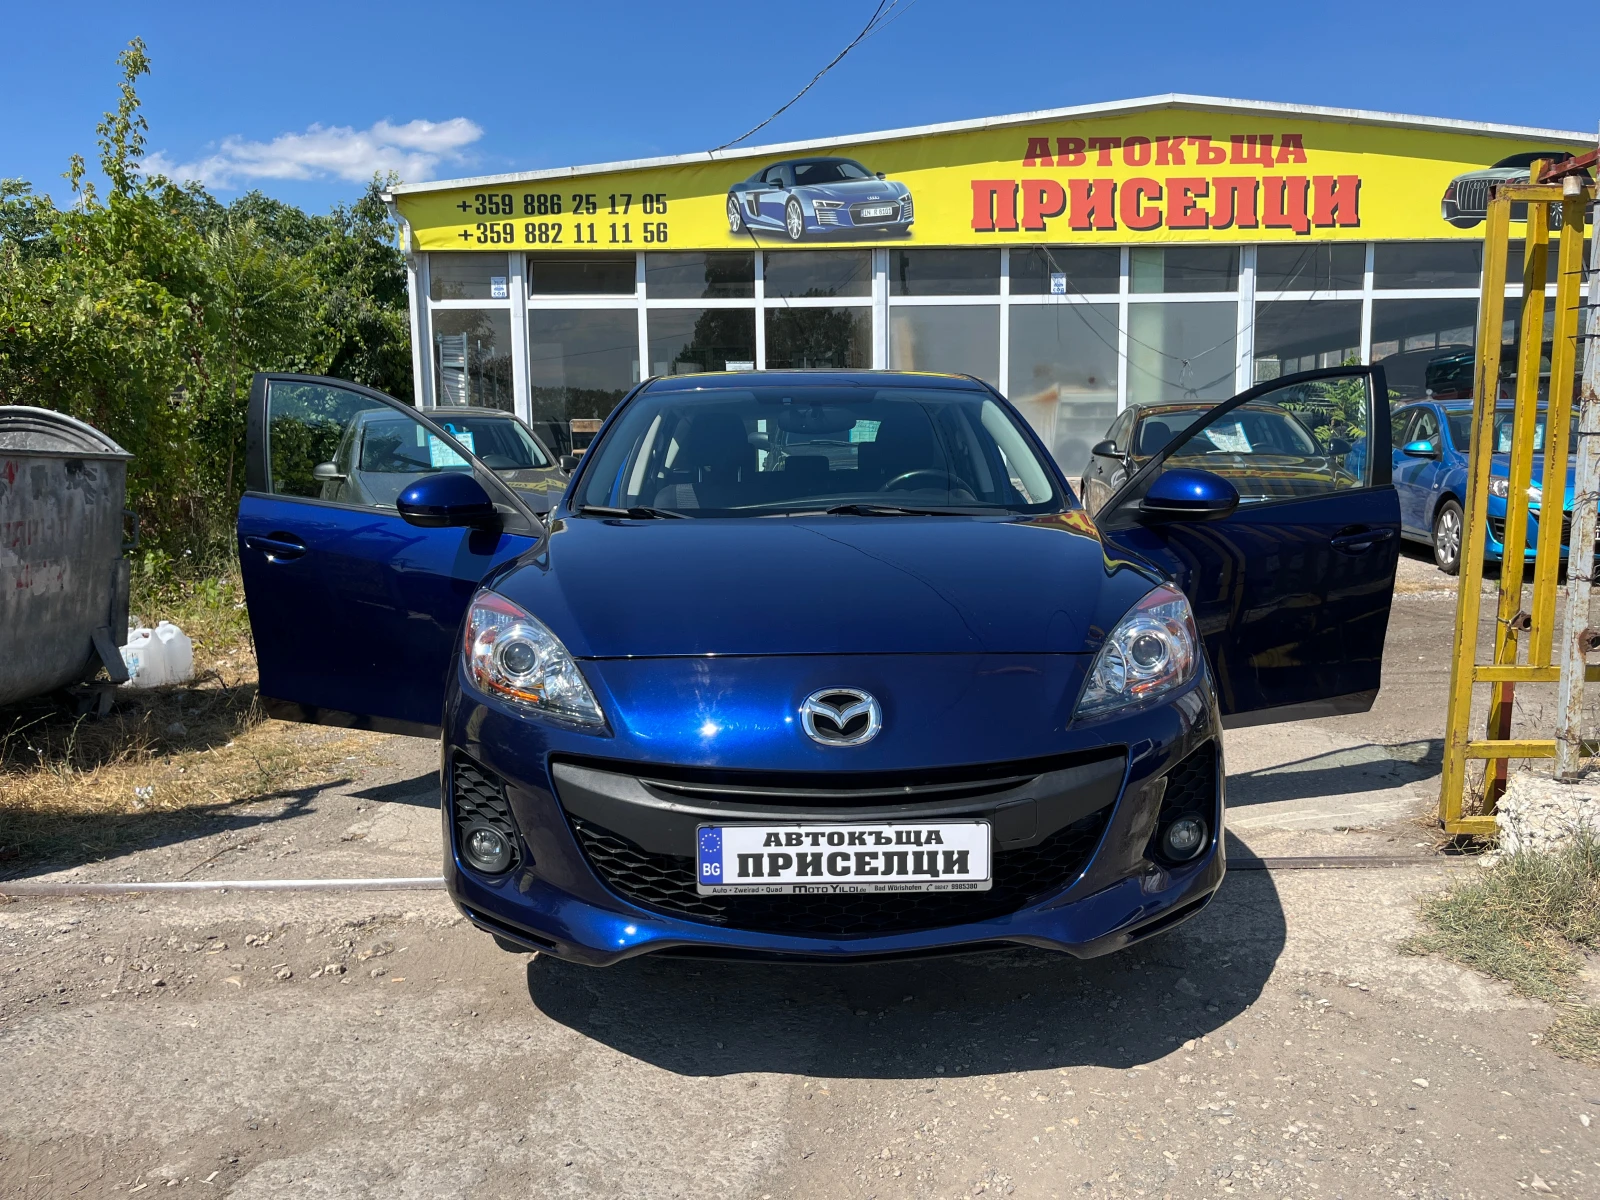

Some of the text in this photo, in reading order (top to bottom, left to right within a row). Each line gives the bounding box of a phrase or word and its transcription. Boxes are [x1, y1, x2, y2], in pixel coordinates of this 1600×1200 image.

[1023, 134, 1307, 168] АВТОКЪЩА
[456, 193, 668, 216] +359 886 25 17 05
[971, 174, 1362, 234] ПРИСЕЛЦИ
[458, 222, 668, 245] +359 882 11 11 56
[763, 830, 944, 847] АВТОКЪЩА
[703, 863, 720, 876] BG
[737, 850, 970, 878] ПРИСЕЛЦИ
[766, 886, 783, 894] Quad
